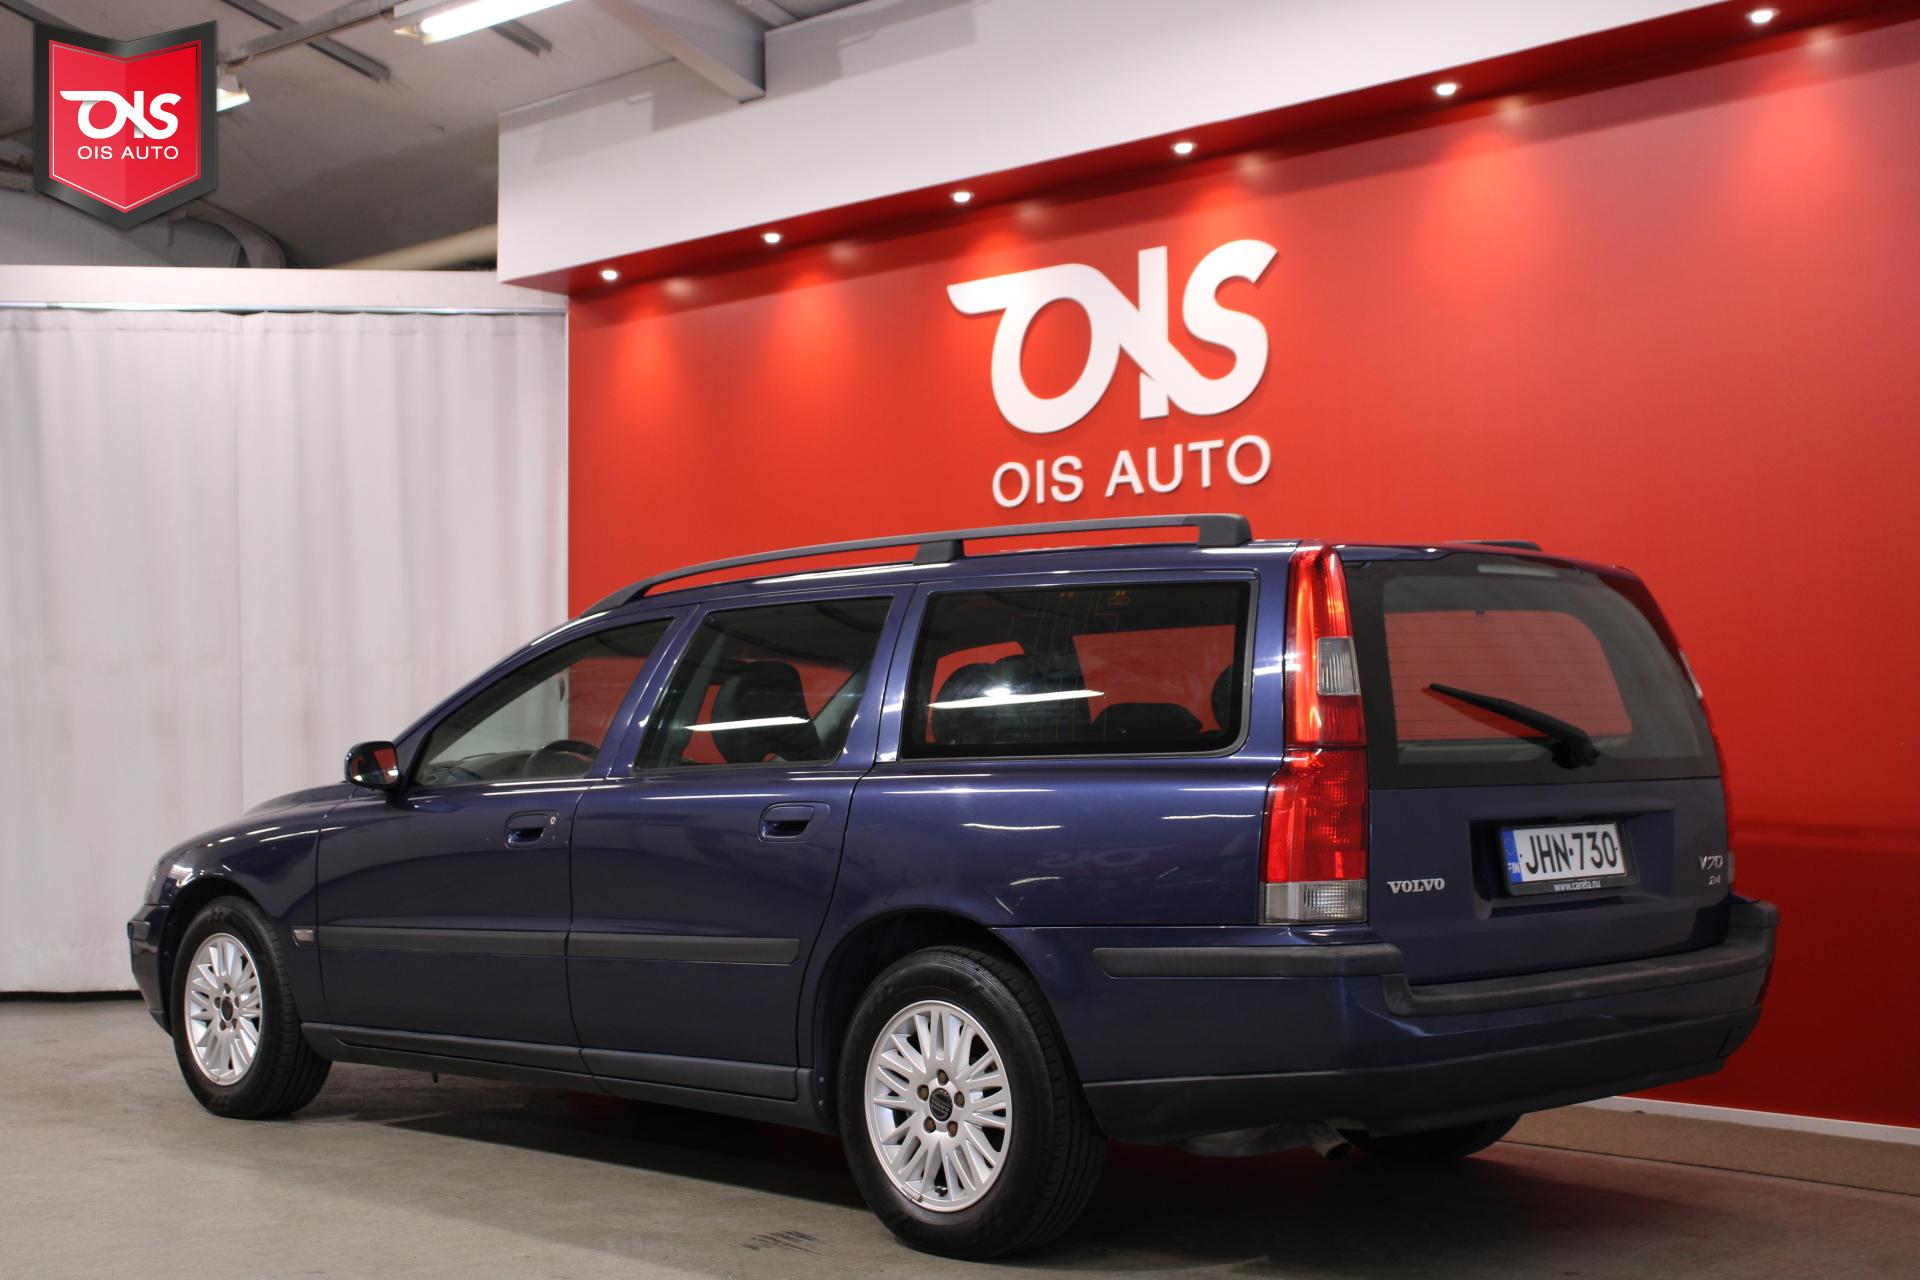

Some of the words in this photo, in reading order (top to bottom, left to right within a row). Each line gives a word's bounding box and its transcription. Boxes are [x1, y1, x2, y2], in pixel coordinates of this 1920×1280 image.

[992, 455, 1085, 508] OIS
[1104, 435, 1272, 497] AUTO
[1698, 855, 1724, 871] V70
[1387, 878, 1446, 894] VOLVO
